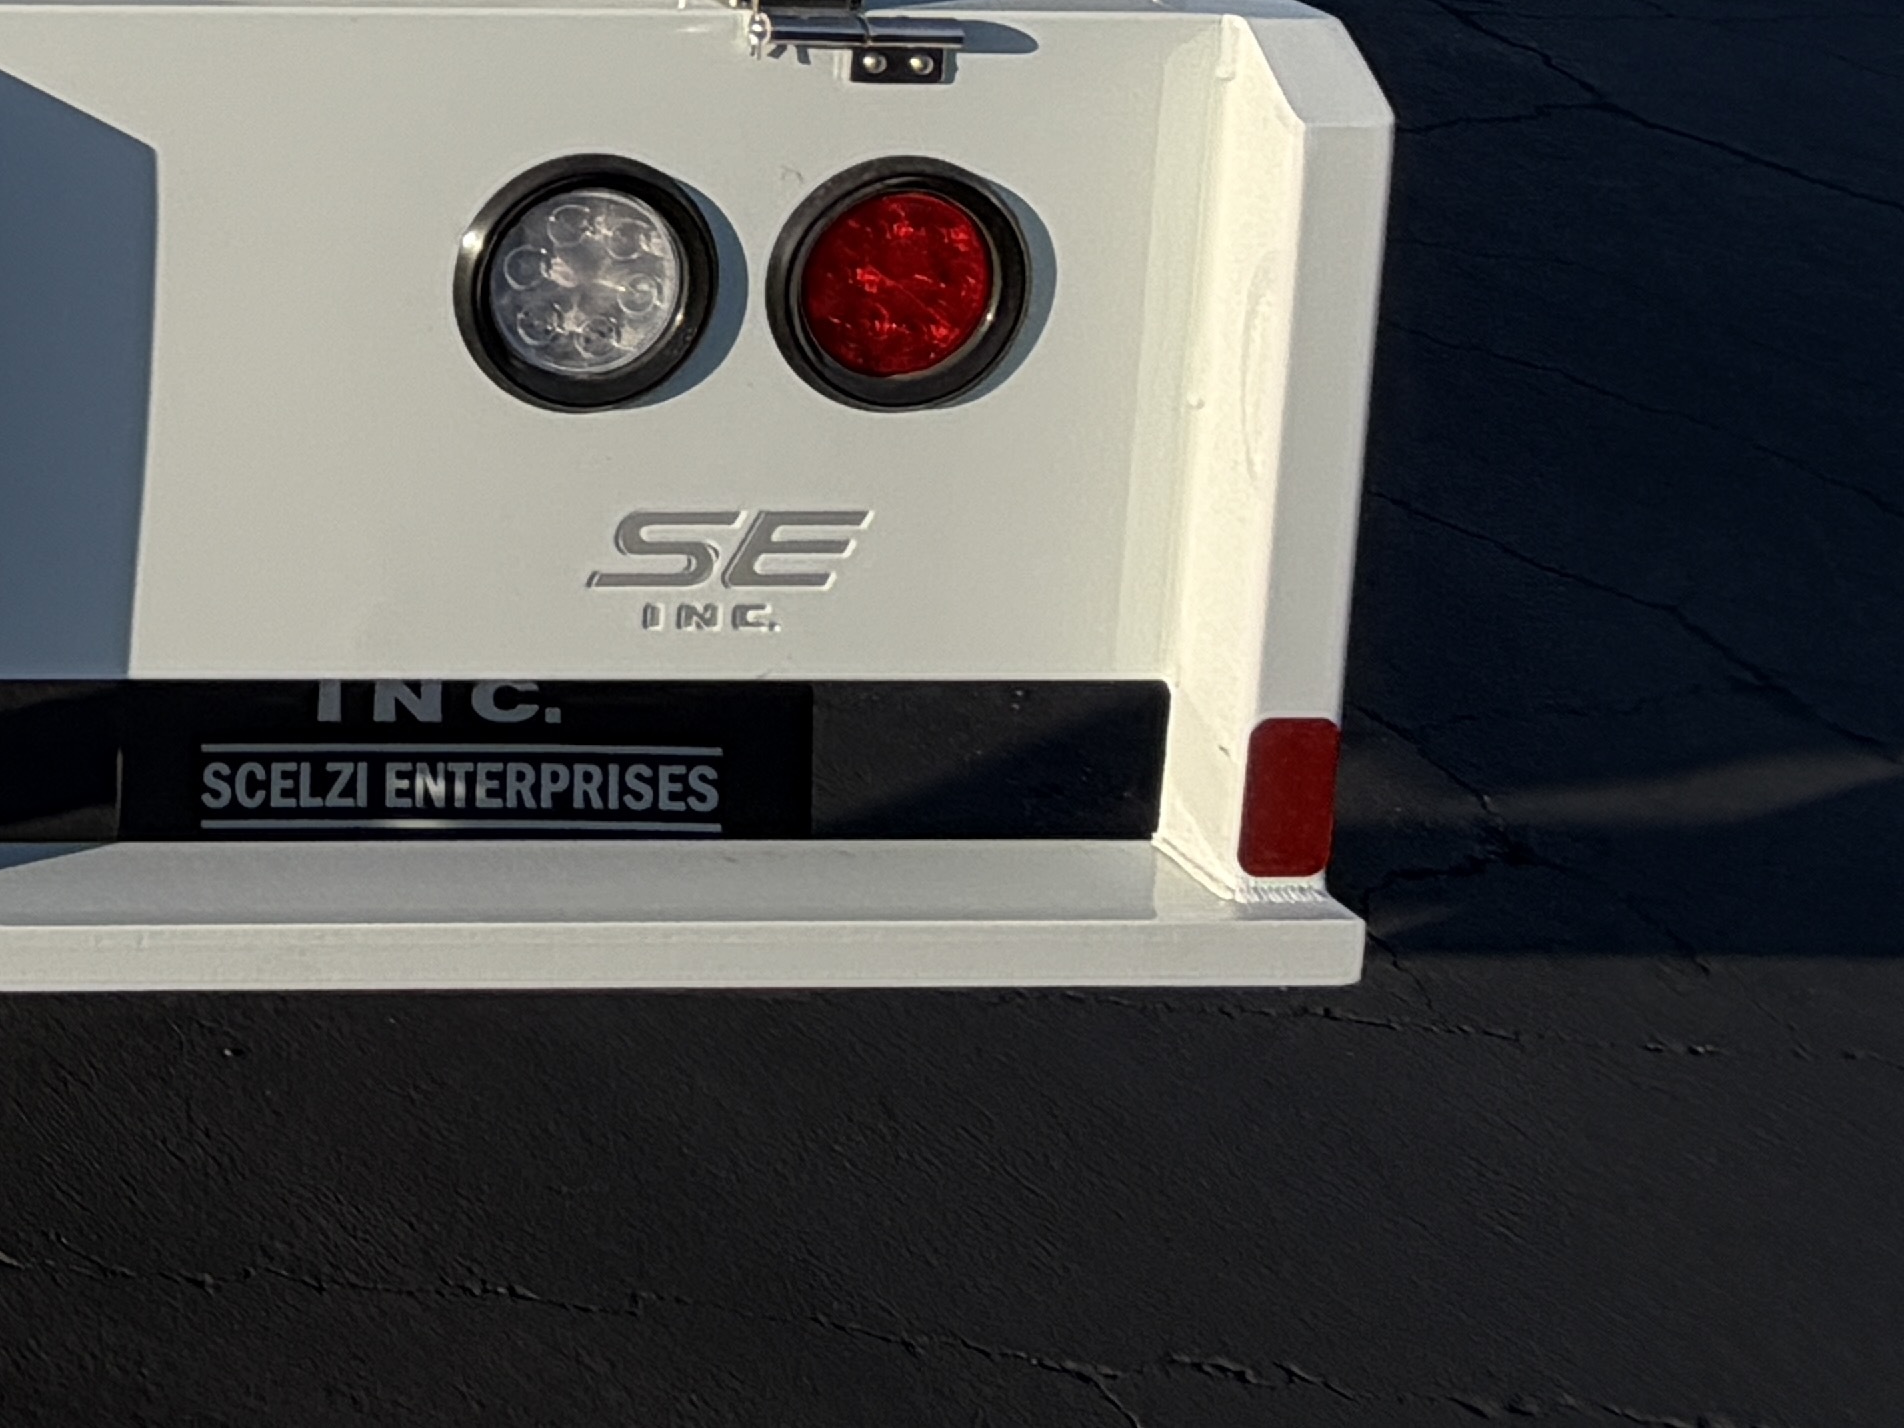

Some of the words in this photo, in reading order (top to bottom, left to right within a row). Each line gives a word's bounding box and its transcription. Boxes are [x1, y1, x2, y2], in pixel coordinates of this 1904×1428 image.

[641, 602, 783, 631] INC.
[200, 761, 369, 810] SCELZI
[384, 761, 721, 812] ENTERPRISES
